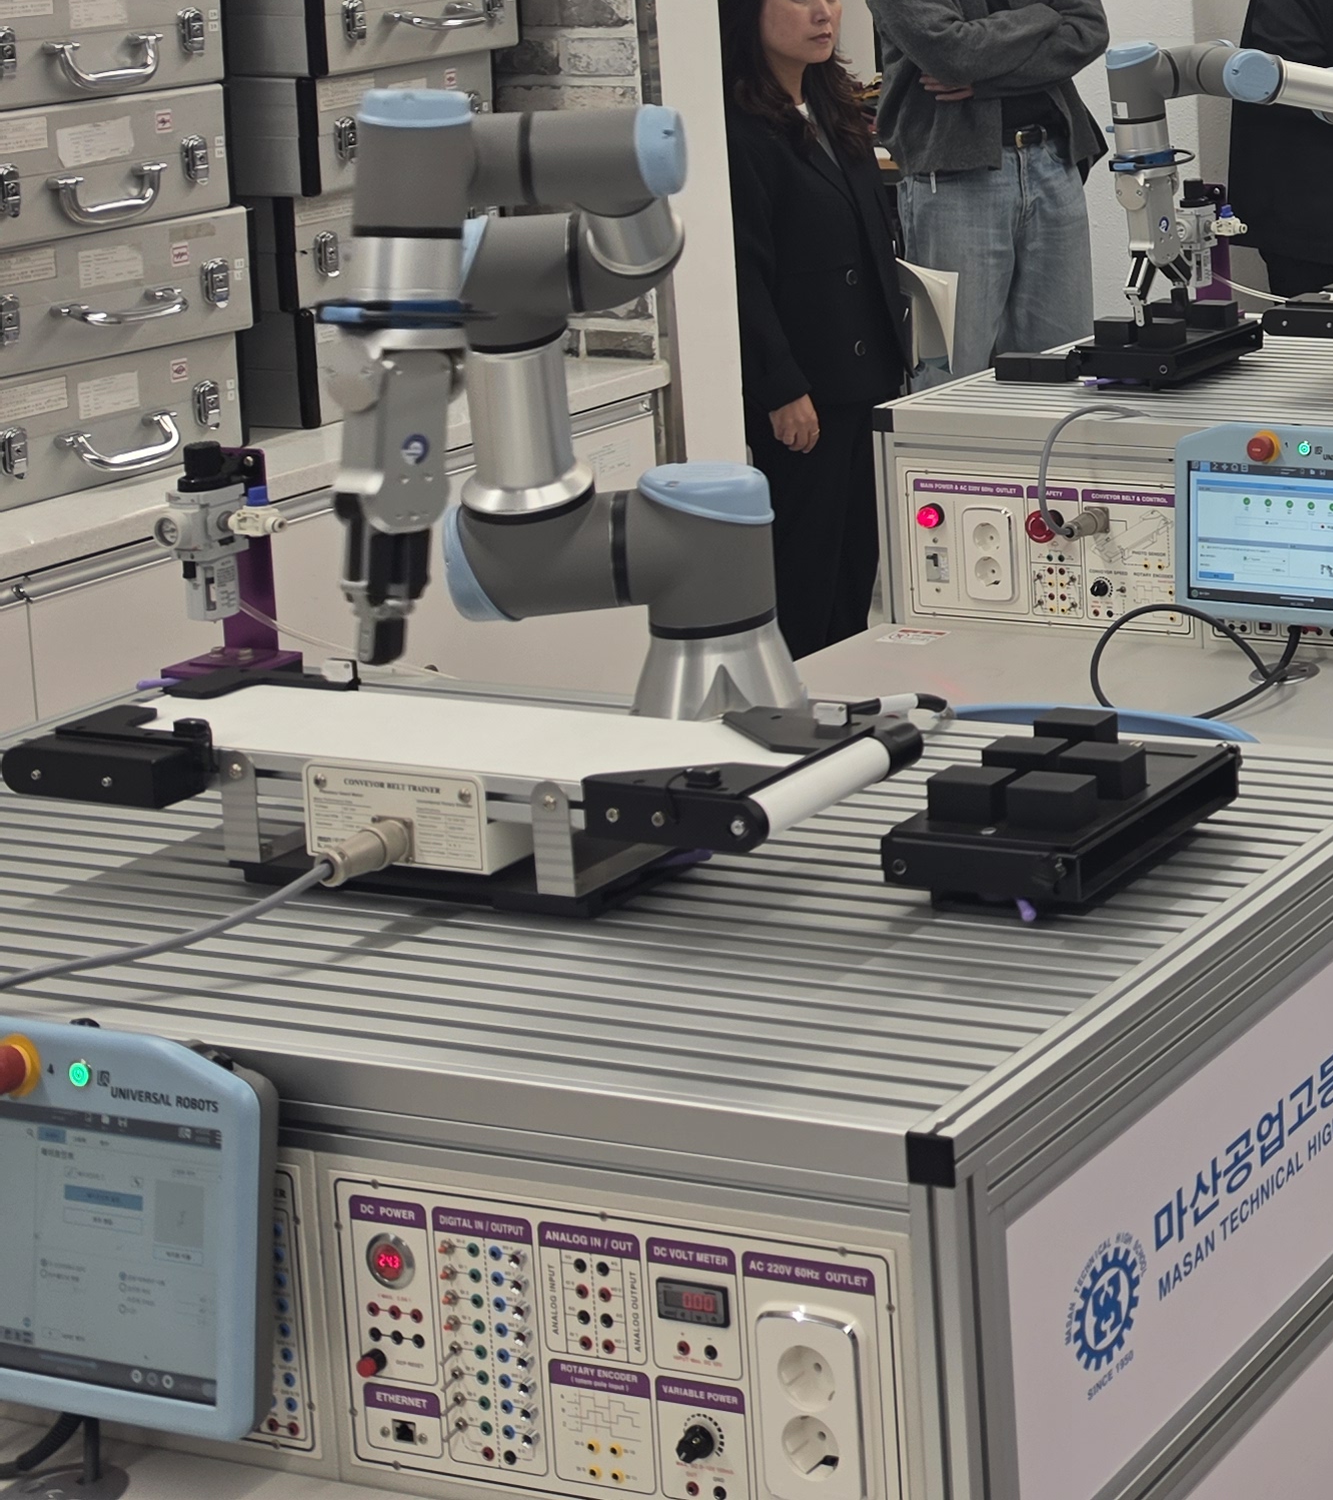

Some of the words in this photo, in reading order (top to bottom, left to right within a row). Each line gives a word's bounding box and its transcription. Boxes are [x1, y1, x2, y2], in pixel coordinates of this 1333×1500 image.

[1091, 492, 1120, 501] CONVEYOR
[1121, 494, 1134, 502] BELT
[1142, 495, 1168, 503] CONTROL
[343, 777, 385, 789] CONVEYOR
[386, 782, 405, 791] BELT
[407, 785, 441, 794] TRAINER
[111, 1086, 172, 1107] UNIVERSAL
[176, 1095, 219, 1113] ROBOTS
[360, 1204, 374, 1215] DC
[380, 1206, 415, 1221] POWER
[439, 1215, 473, 1229] DIGITAL
[474, 1220, 483, 1231] IN
[490, 1222, 523, 1237] OUTPUT
[1158, 1231, 1215, 1301] MASAN
[1220, 1151, 1304, 1241] TECHNICAL
[545, 1230, 588, 1247] ANALOG
[590, 1236, 600, 1247] IN
[611, 1239, 633, 1252] OUT
[653, 1246, 667, 1257] DC
[669, 1248, 695, 1261] VOLT
[696, 1252, 728, 1267] METER
[548, 1264, 556, 1295] INPUT
[749, 1260, 764, 1272] AC
[767, 1262, 792, 1276] 220V
[794, 1266, 820, 1280] 60Hz
[825, 1271, 868, 1288] OUTLET
[629, 1271, 638, 1306] OUTPUT
[550, 1295, 559, 1335] ANALOG
[631, 1306, 642, 1353] ANALOG
[560, 1363, 595, 1376] ROTARY
[597, 1368, 638, 1384] ENCODER
[1087, 1369, 1113, 1400] SINCE
[376, 1392, 428, 1409] ETHERNET
[661, 1384, 706, 1400] VARIABLE
[707, 1392, 739, 1405] POWER
